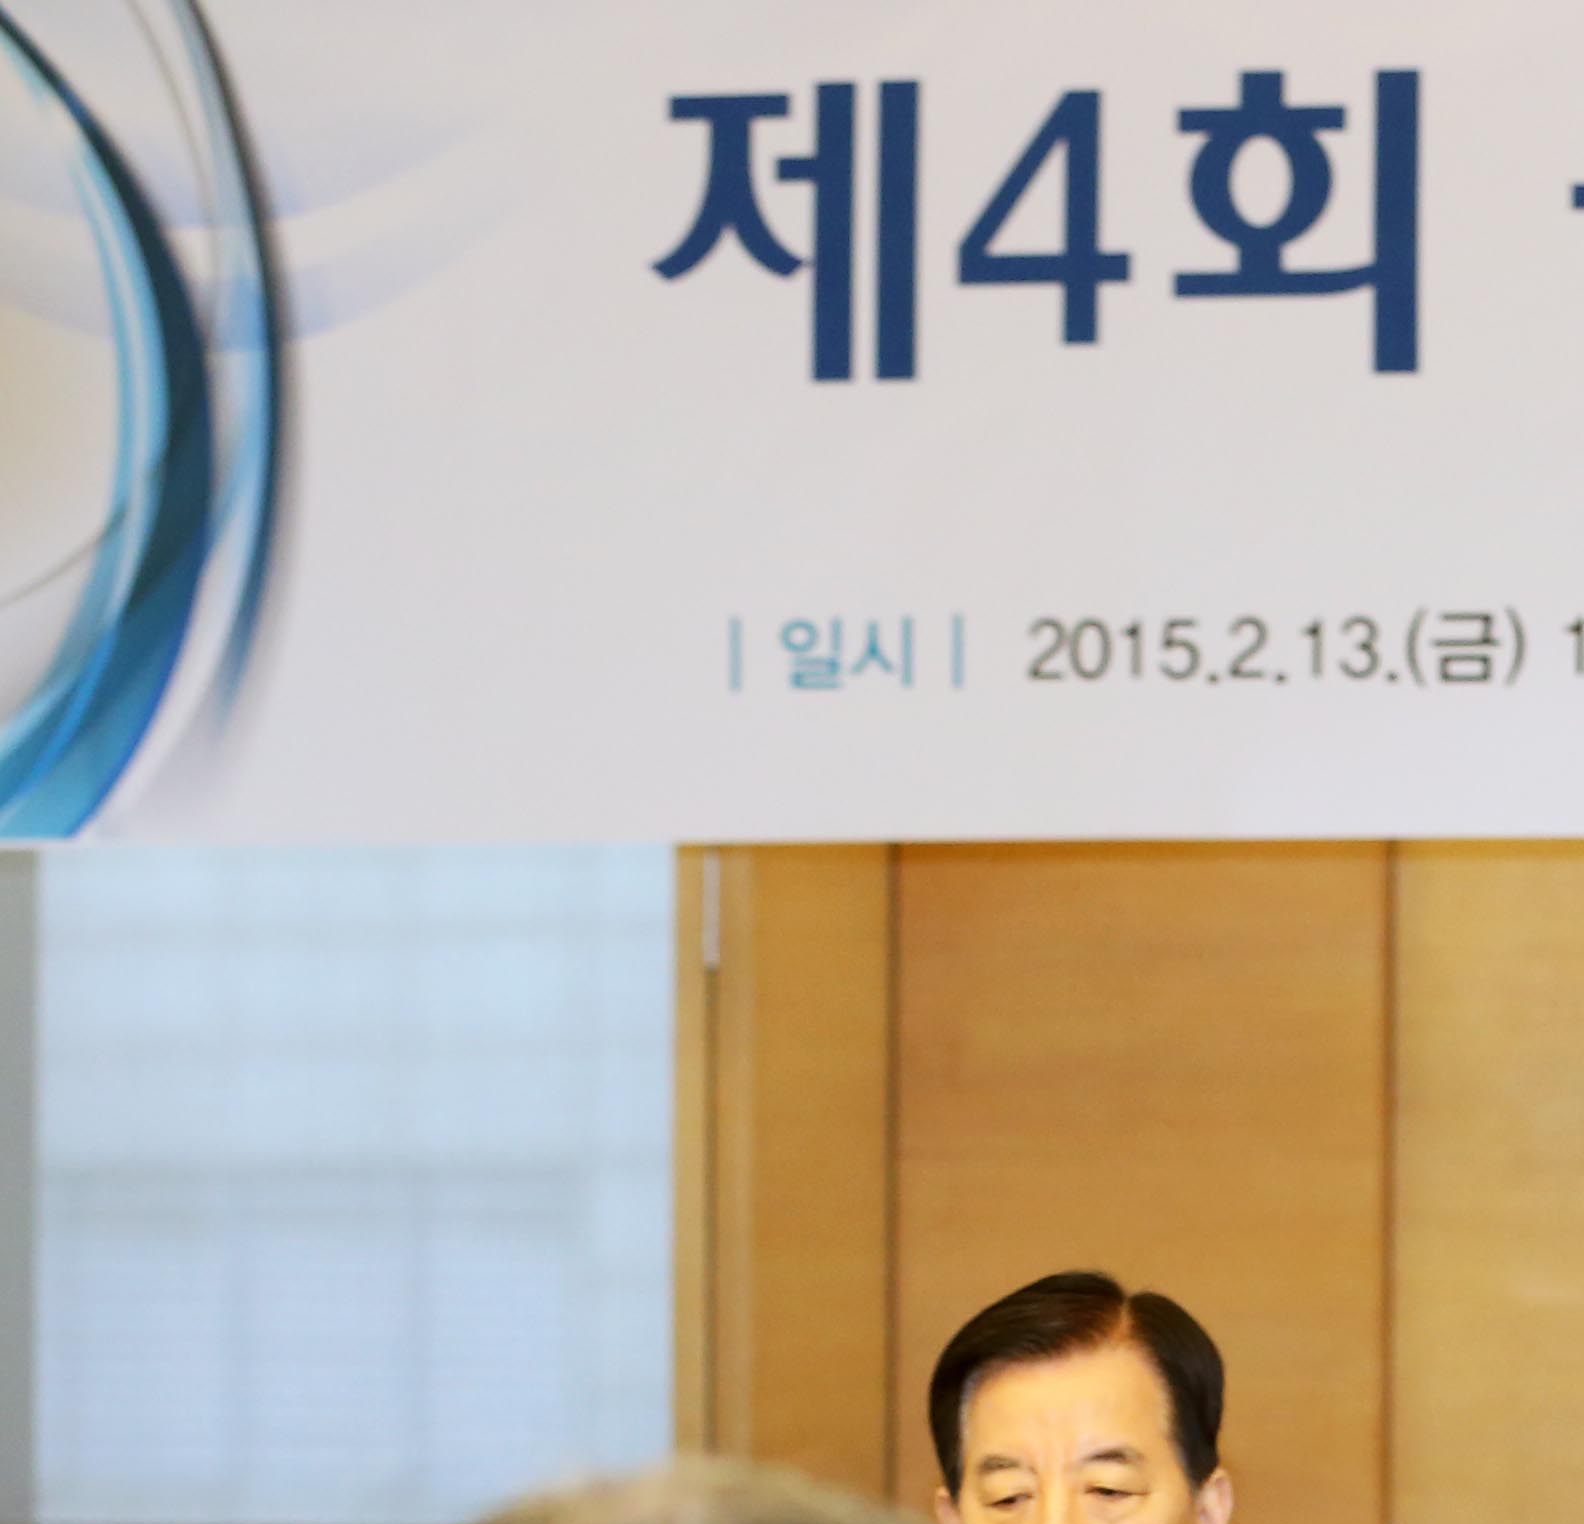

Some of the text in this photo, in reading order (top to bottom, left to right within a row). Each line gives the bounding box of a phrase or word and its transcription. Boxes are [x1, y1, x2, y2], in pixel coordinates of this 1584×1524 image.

[651, 69, 1420, 383] 제4회
[779, 617, 914, 690] 일시
[1026, 610, 1527, 685] 2015.2.13.(금)
